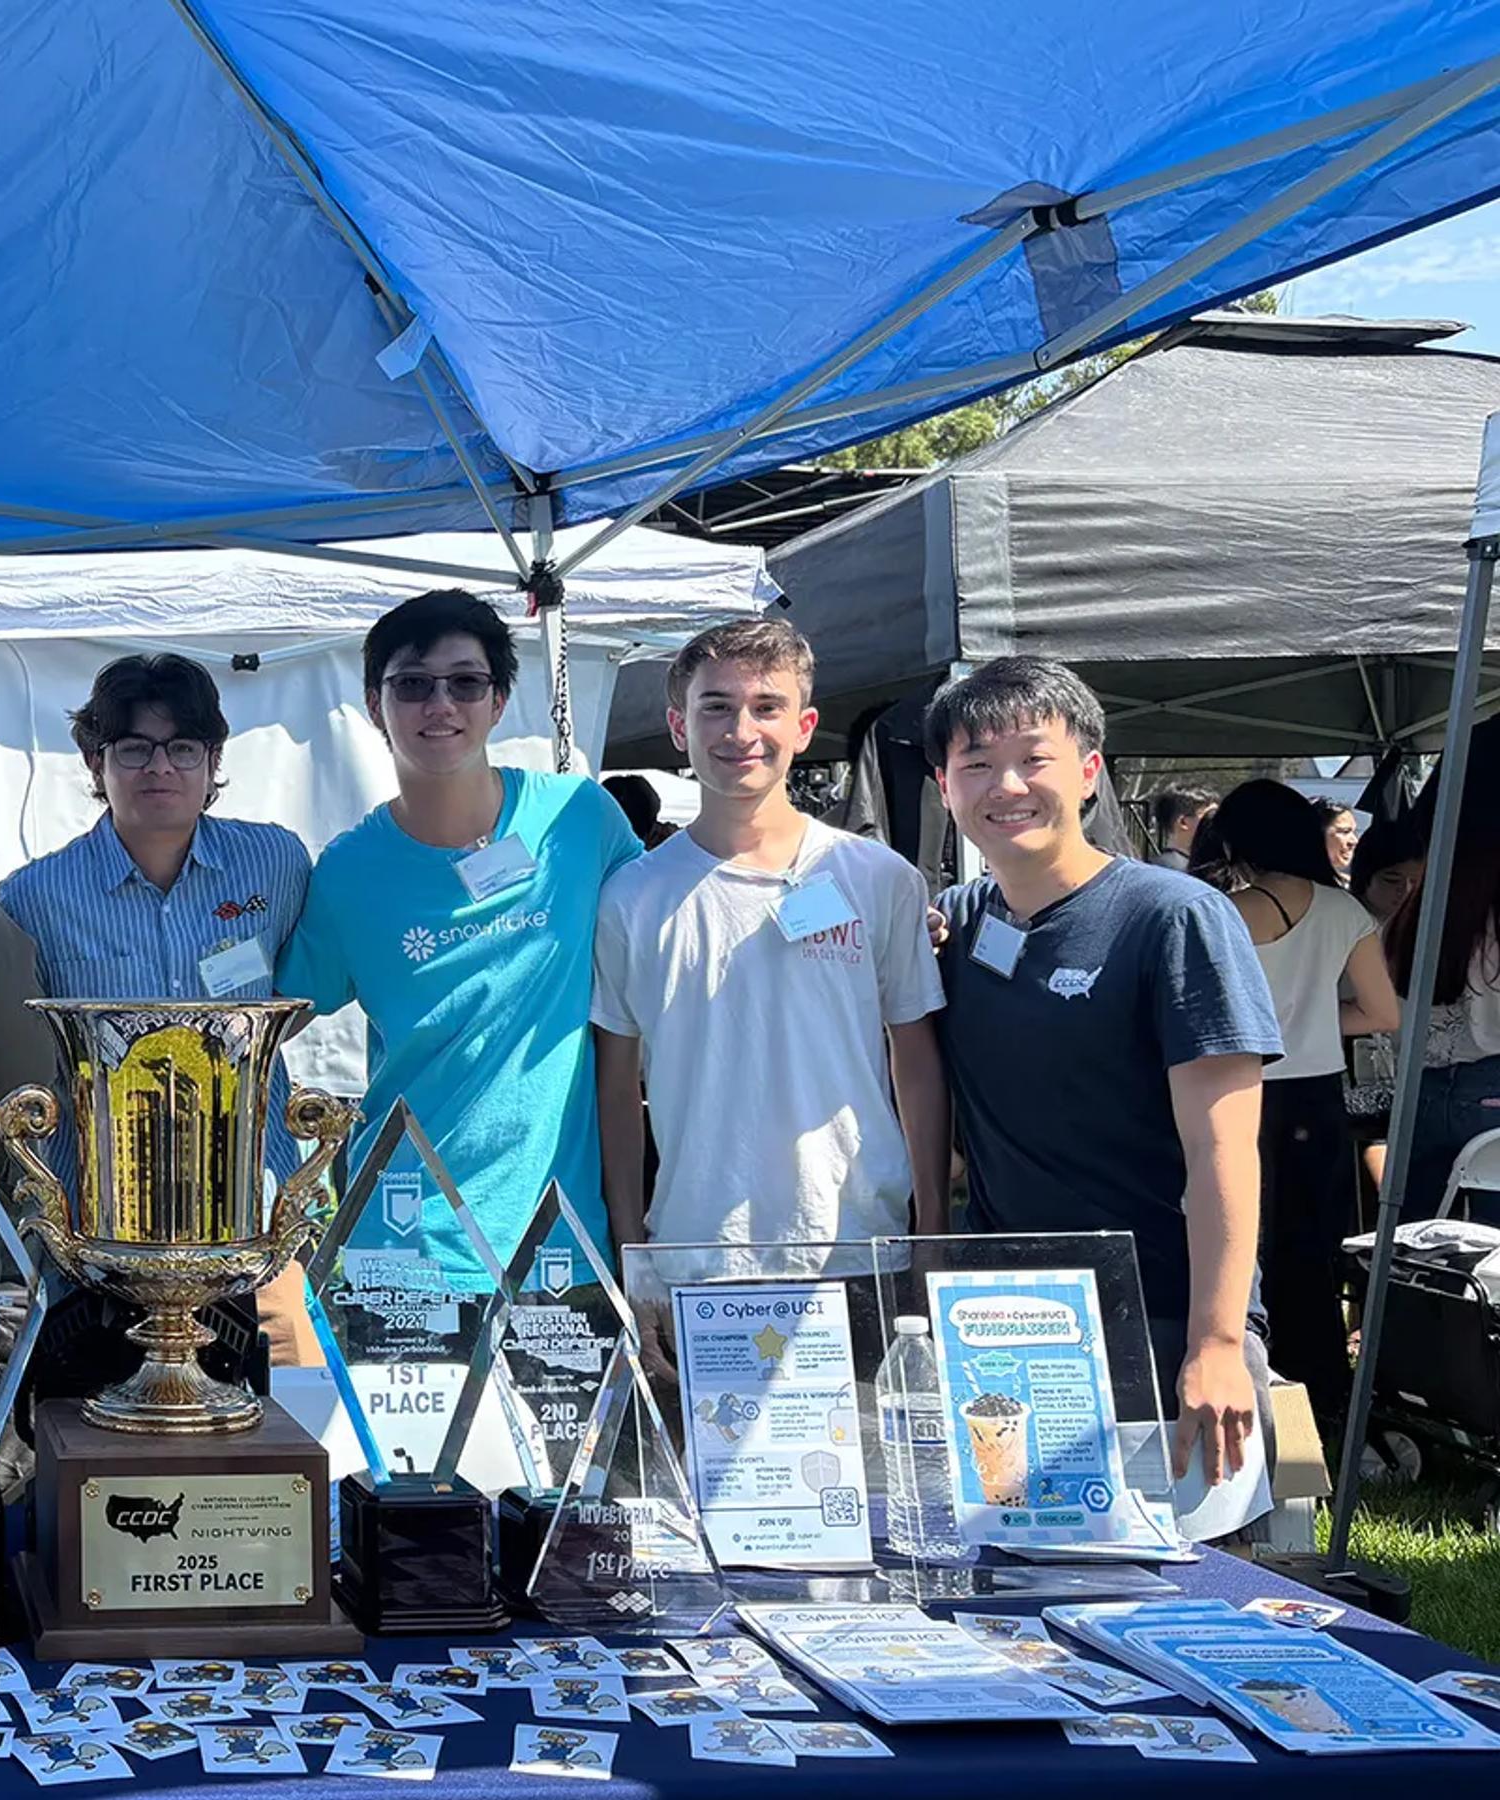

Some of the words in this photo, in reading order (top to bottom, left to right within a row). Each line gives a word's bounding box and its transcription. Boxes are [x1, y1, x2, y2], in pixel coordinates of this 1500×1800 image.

[438, 910, 548, 945] snowflake
[334, 1292, 393, 1304] CYBER
[395, 1291, 476, 1303] DEFENSE
[722, 1300, 824, 1319] Cyber@UCI
[385, 1314, 427, 1329] 2021
[521, 1312, 588, 1323] WESTERN
[522, 1323, 595, 1338] REGIONAL
[963, 1322, 1071, 1337] FUNDRAISER!
[386, 1364, 428, 1385] 1ST
[370, 1391, 446, 1414] PLACE
[540, 1402, 579, 1421] 2ND
[530, 1421, 588, 1441] PLACE
[116, 1511, 173, 1526] CCDC
[191, 1526, 292, 1539] NIGHTWING
[177, 1555, 218, 1570] 2025
[586, 1551, 616, 1581] 1st
[617, 1553, 671, 1579] Place
[131, 1574, 193, 1592] FIRST
[200, 1573, 264, 1590] PLACE
[834, 1633, 949, 1643] Cyber@UCI
